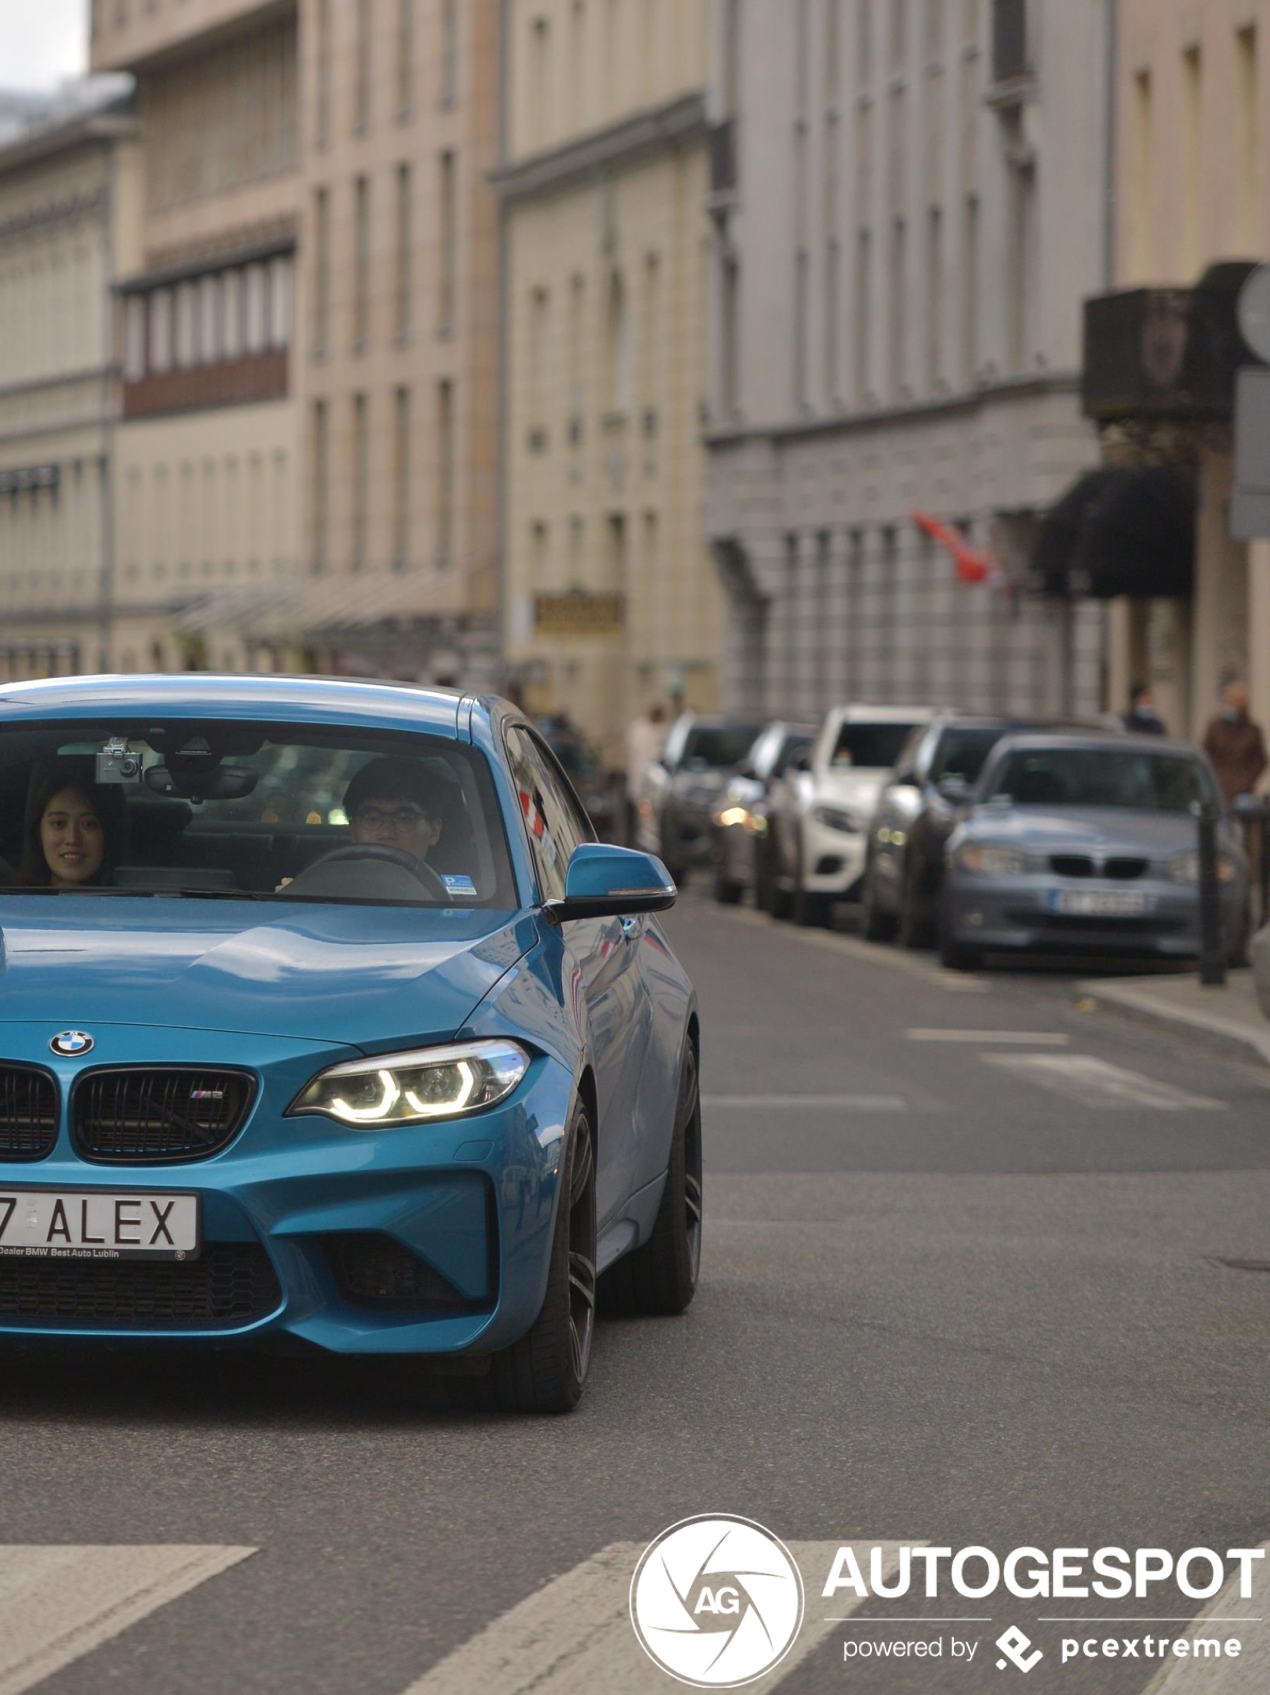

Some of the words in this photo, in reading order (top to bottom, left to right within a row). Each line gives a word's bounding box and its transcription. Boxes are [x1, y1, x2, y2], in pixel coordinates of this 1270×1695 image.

[46, 1198, 175, 1245] ALEX
[25, 1247, 49, 1256] BMW
[50, 1248, 70, 1257] Best
[71, 1249, 91, 1257] Auto
[92, 1249, 119, 1258] Lublin
